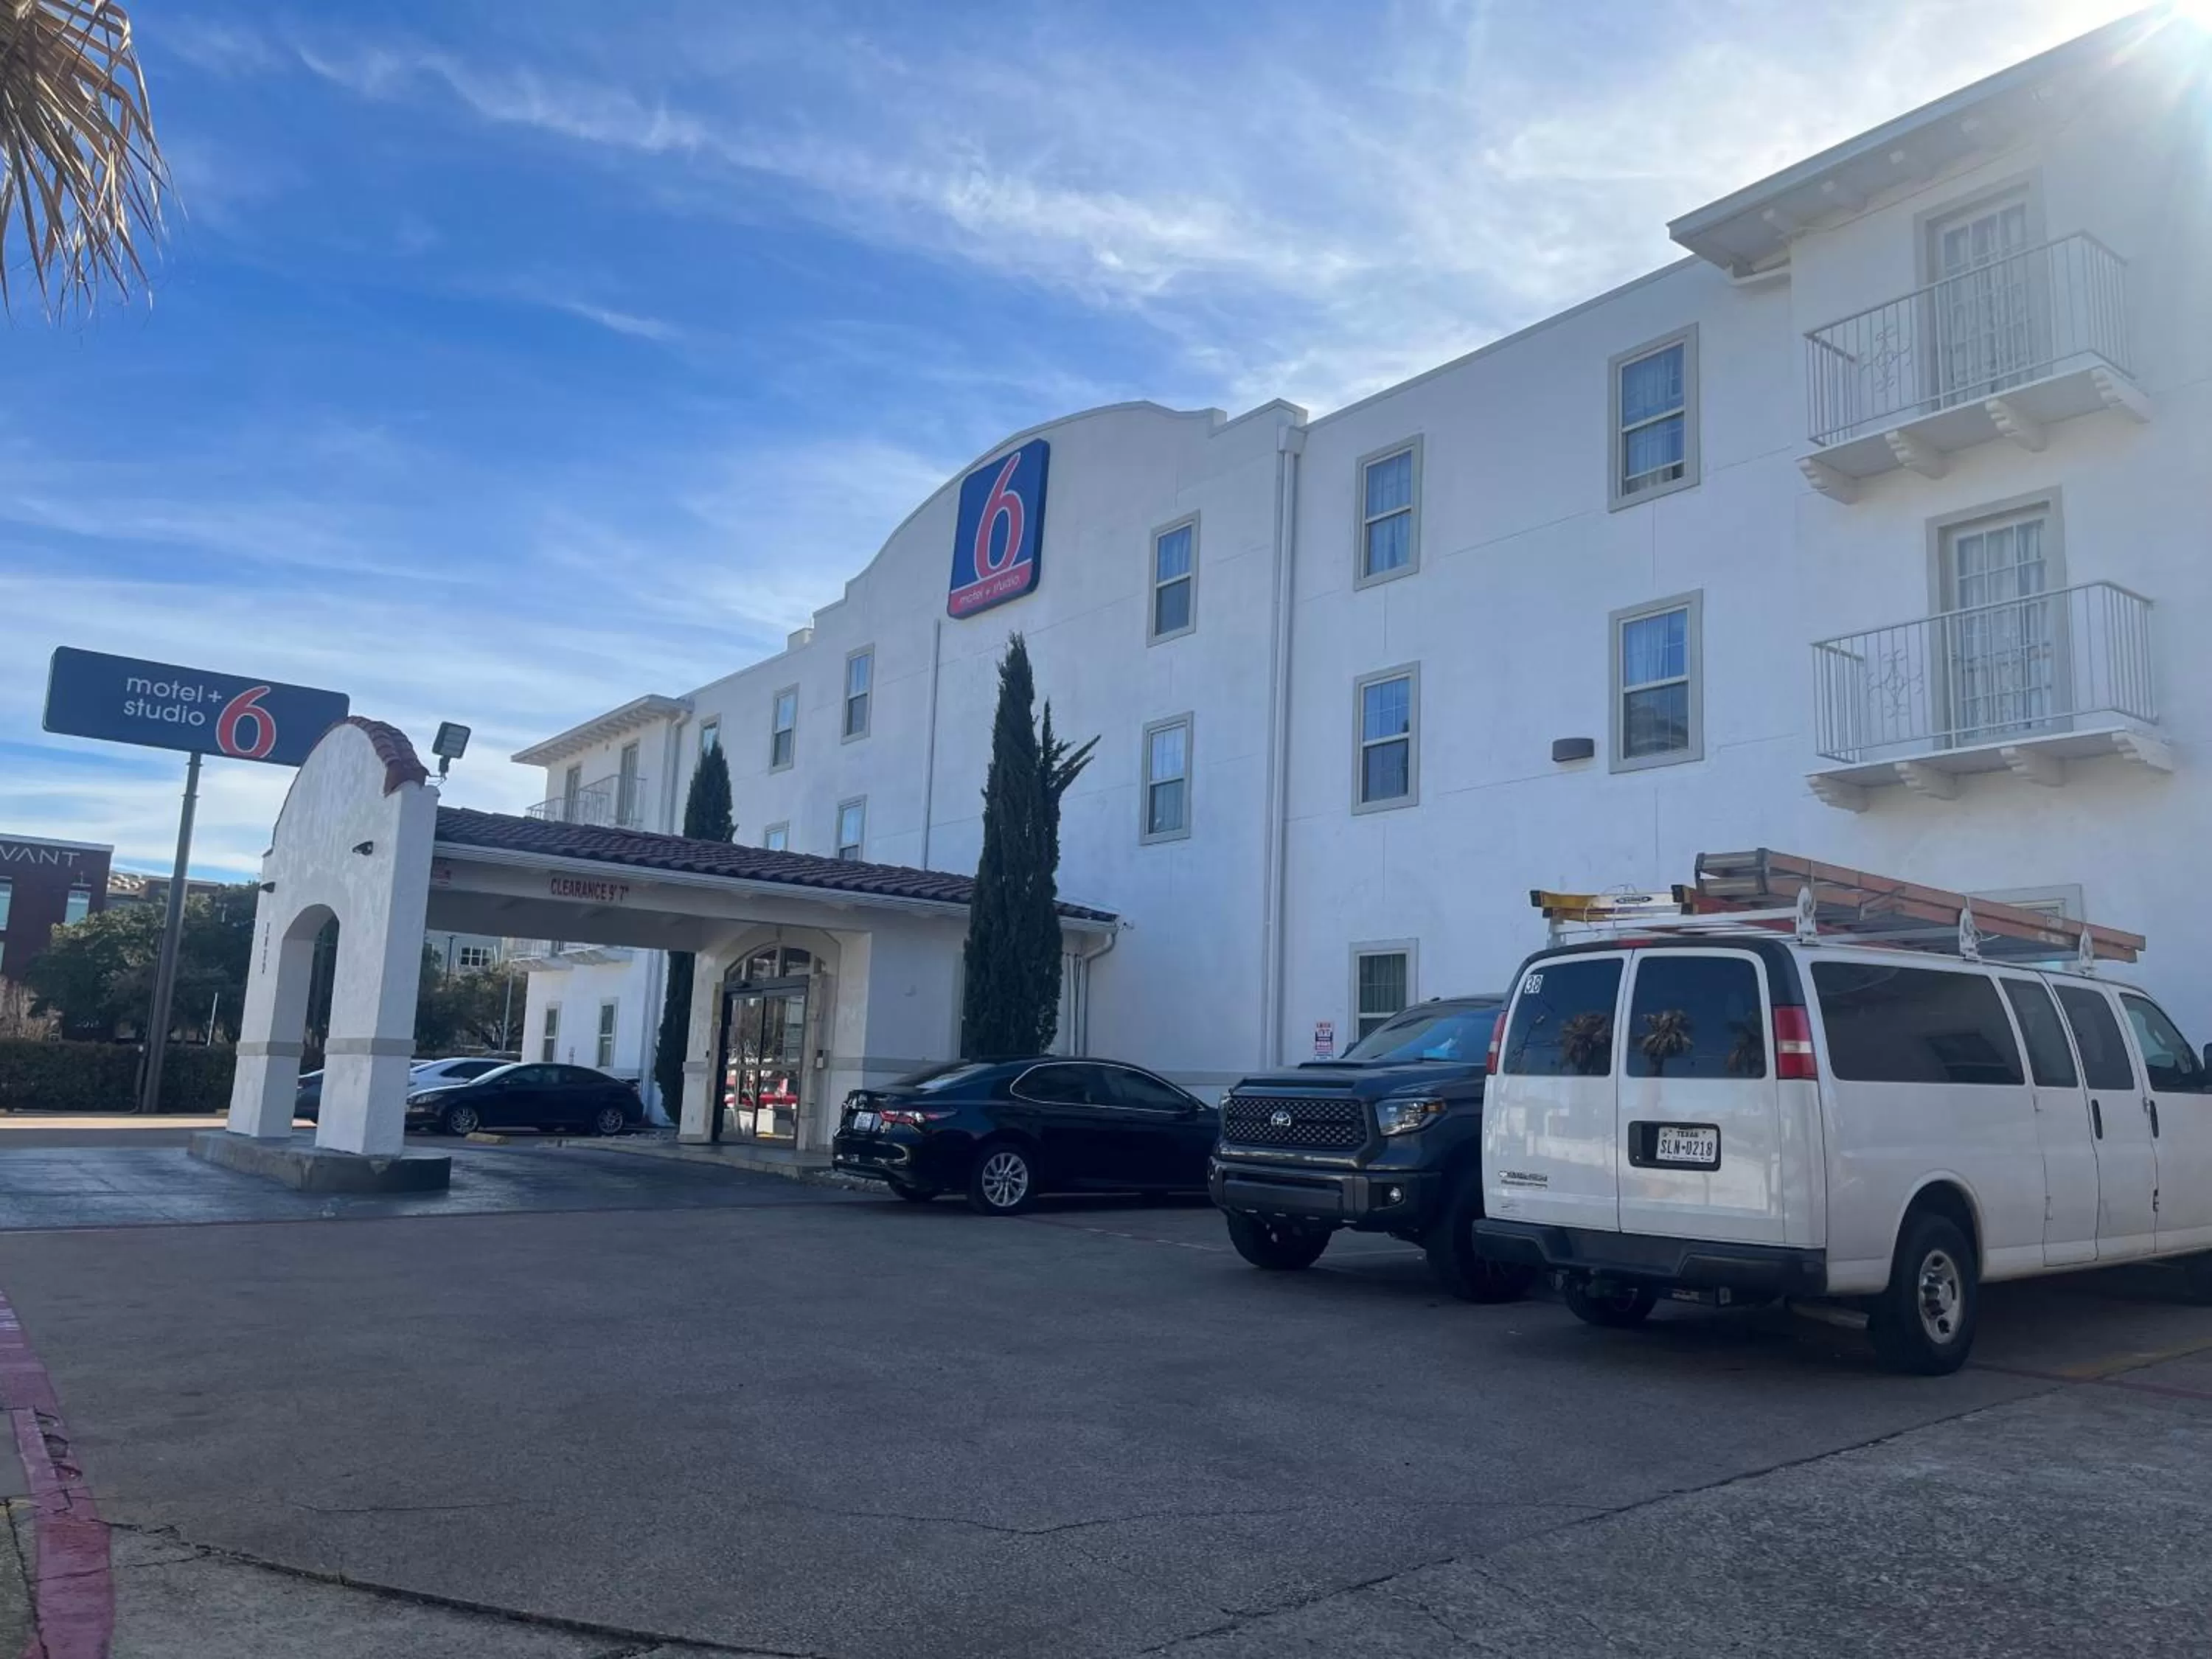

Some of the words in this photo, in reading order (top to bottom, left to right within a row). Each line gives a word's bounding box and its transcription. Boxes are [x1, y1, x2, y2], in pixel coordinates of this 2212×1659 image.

[974, 451, 1024, 581] 6
[126, 677, 204, 703] motel
[123, 698, 206, 726] studio
[216, 685, 276, 759] 6
[551, 878, 607, 900] CLEARANCE
[1676, 1130, 1699, 1138] TEXAS
